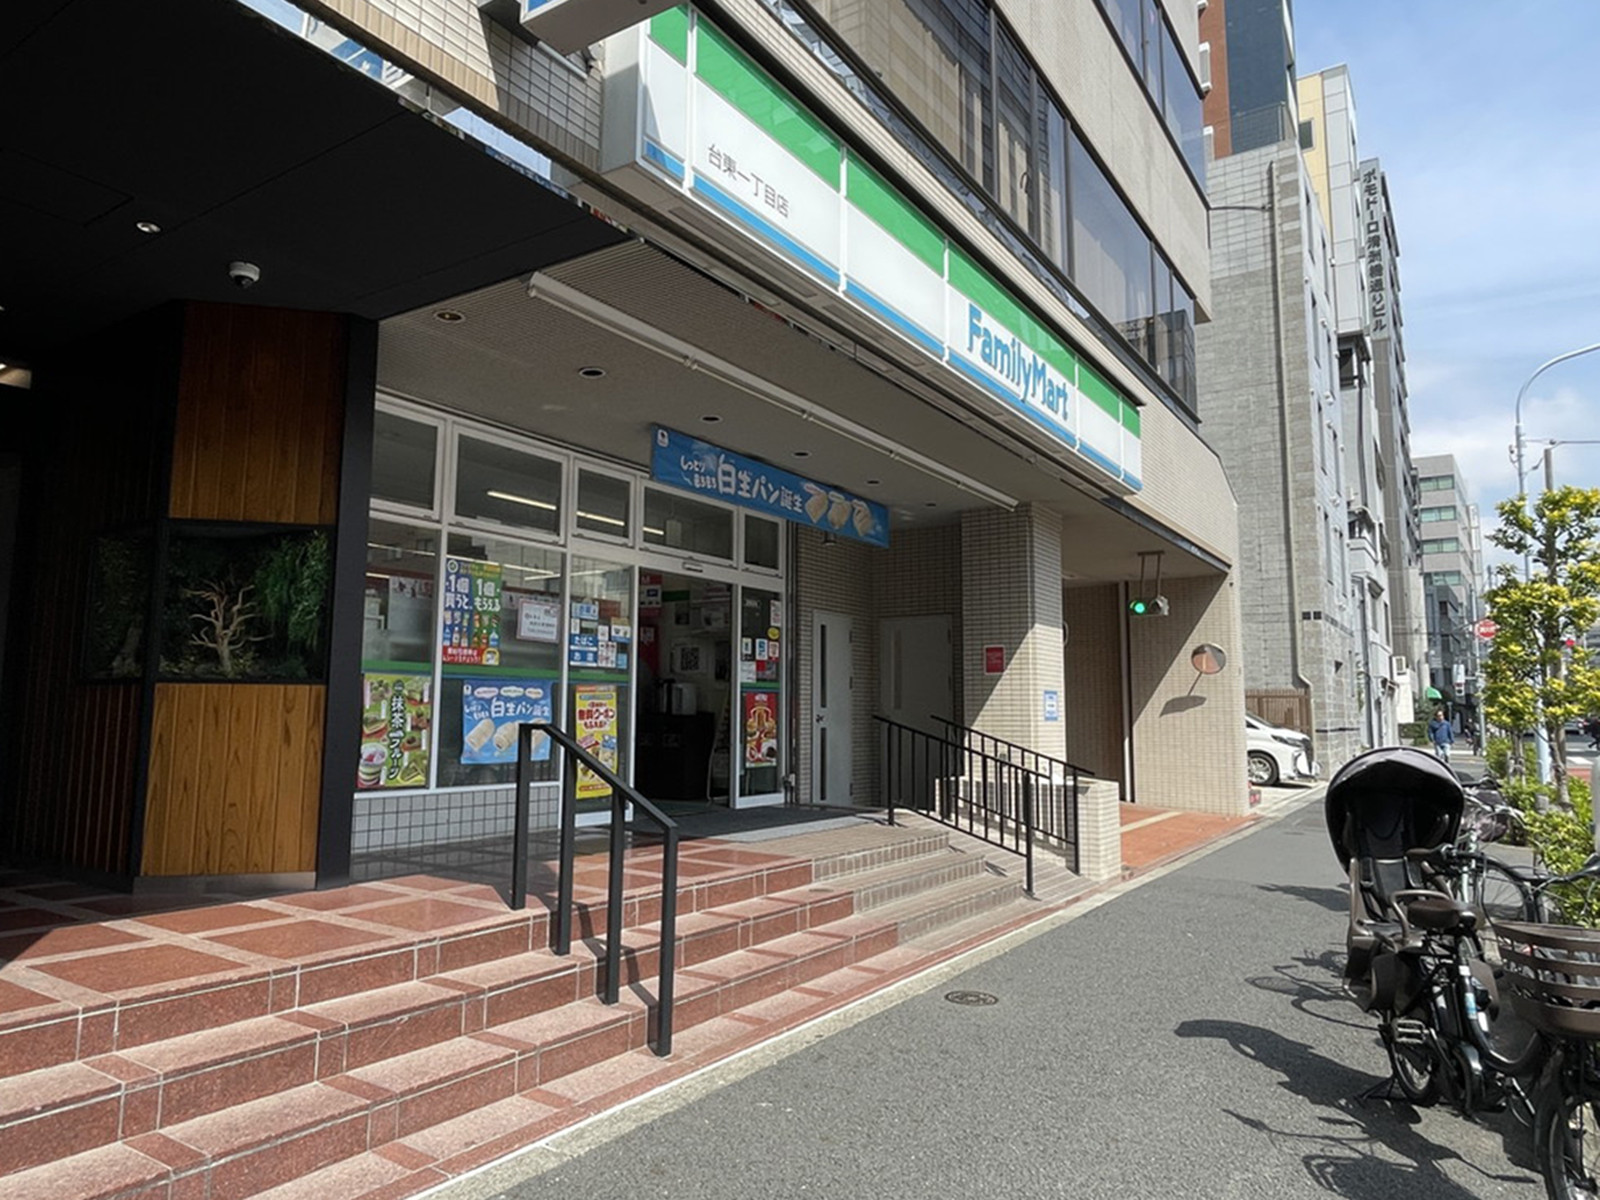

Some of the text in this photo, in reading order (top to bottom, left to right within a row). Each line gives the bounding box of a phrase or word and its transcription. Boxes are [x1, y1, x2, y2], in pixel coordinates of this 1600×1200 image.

[708, 144, 789, 218] 台東一丁目店
[968, 302, 1069, 421] FamilyMart
